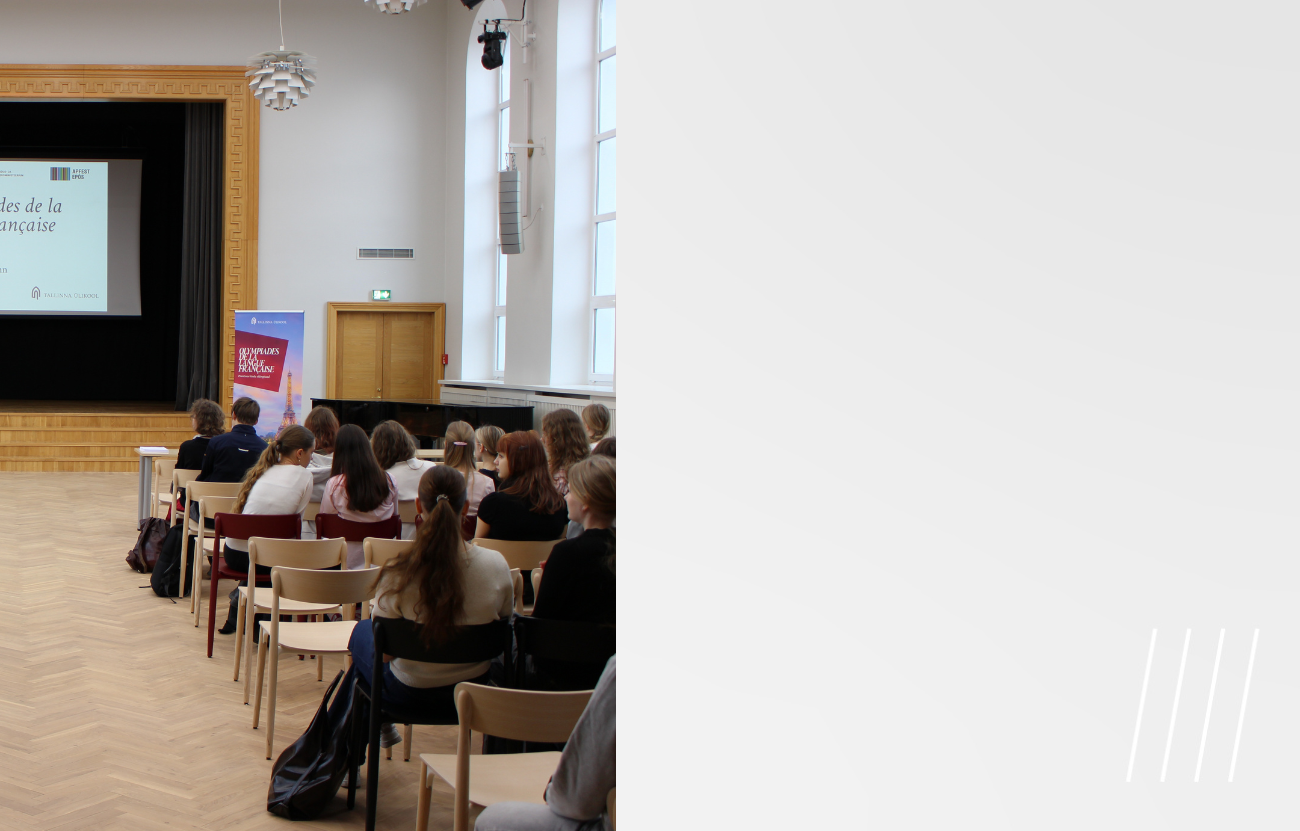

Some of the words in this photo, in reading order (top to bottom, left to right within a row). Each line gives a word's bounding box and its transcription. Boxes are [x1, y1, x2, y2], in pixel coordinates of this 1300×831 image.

[25, 197, 43, 213] de
[48, 197, 62, 213] la
[239, 347, 280, 355] OLYMPIADES
[239, 353, 248, 361] DE
[249, 353, 258, 361] LA
[238, 359, 265, 367] LANGUE
[238, 366, 275, 374] FRANÇAISE
